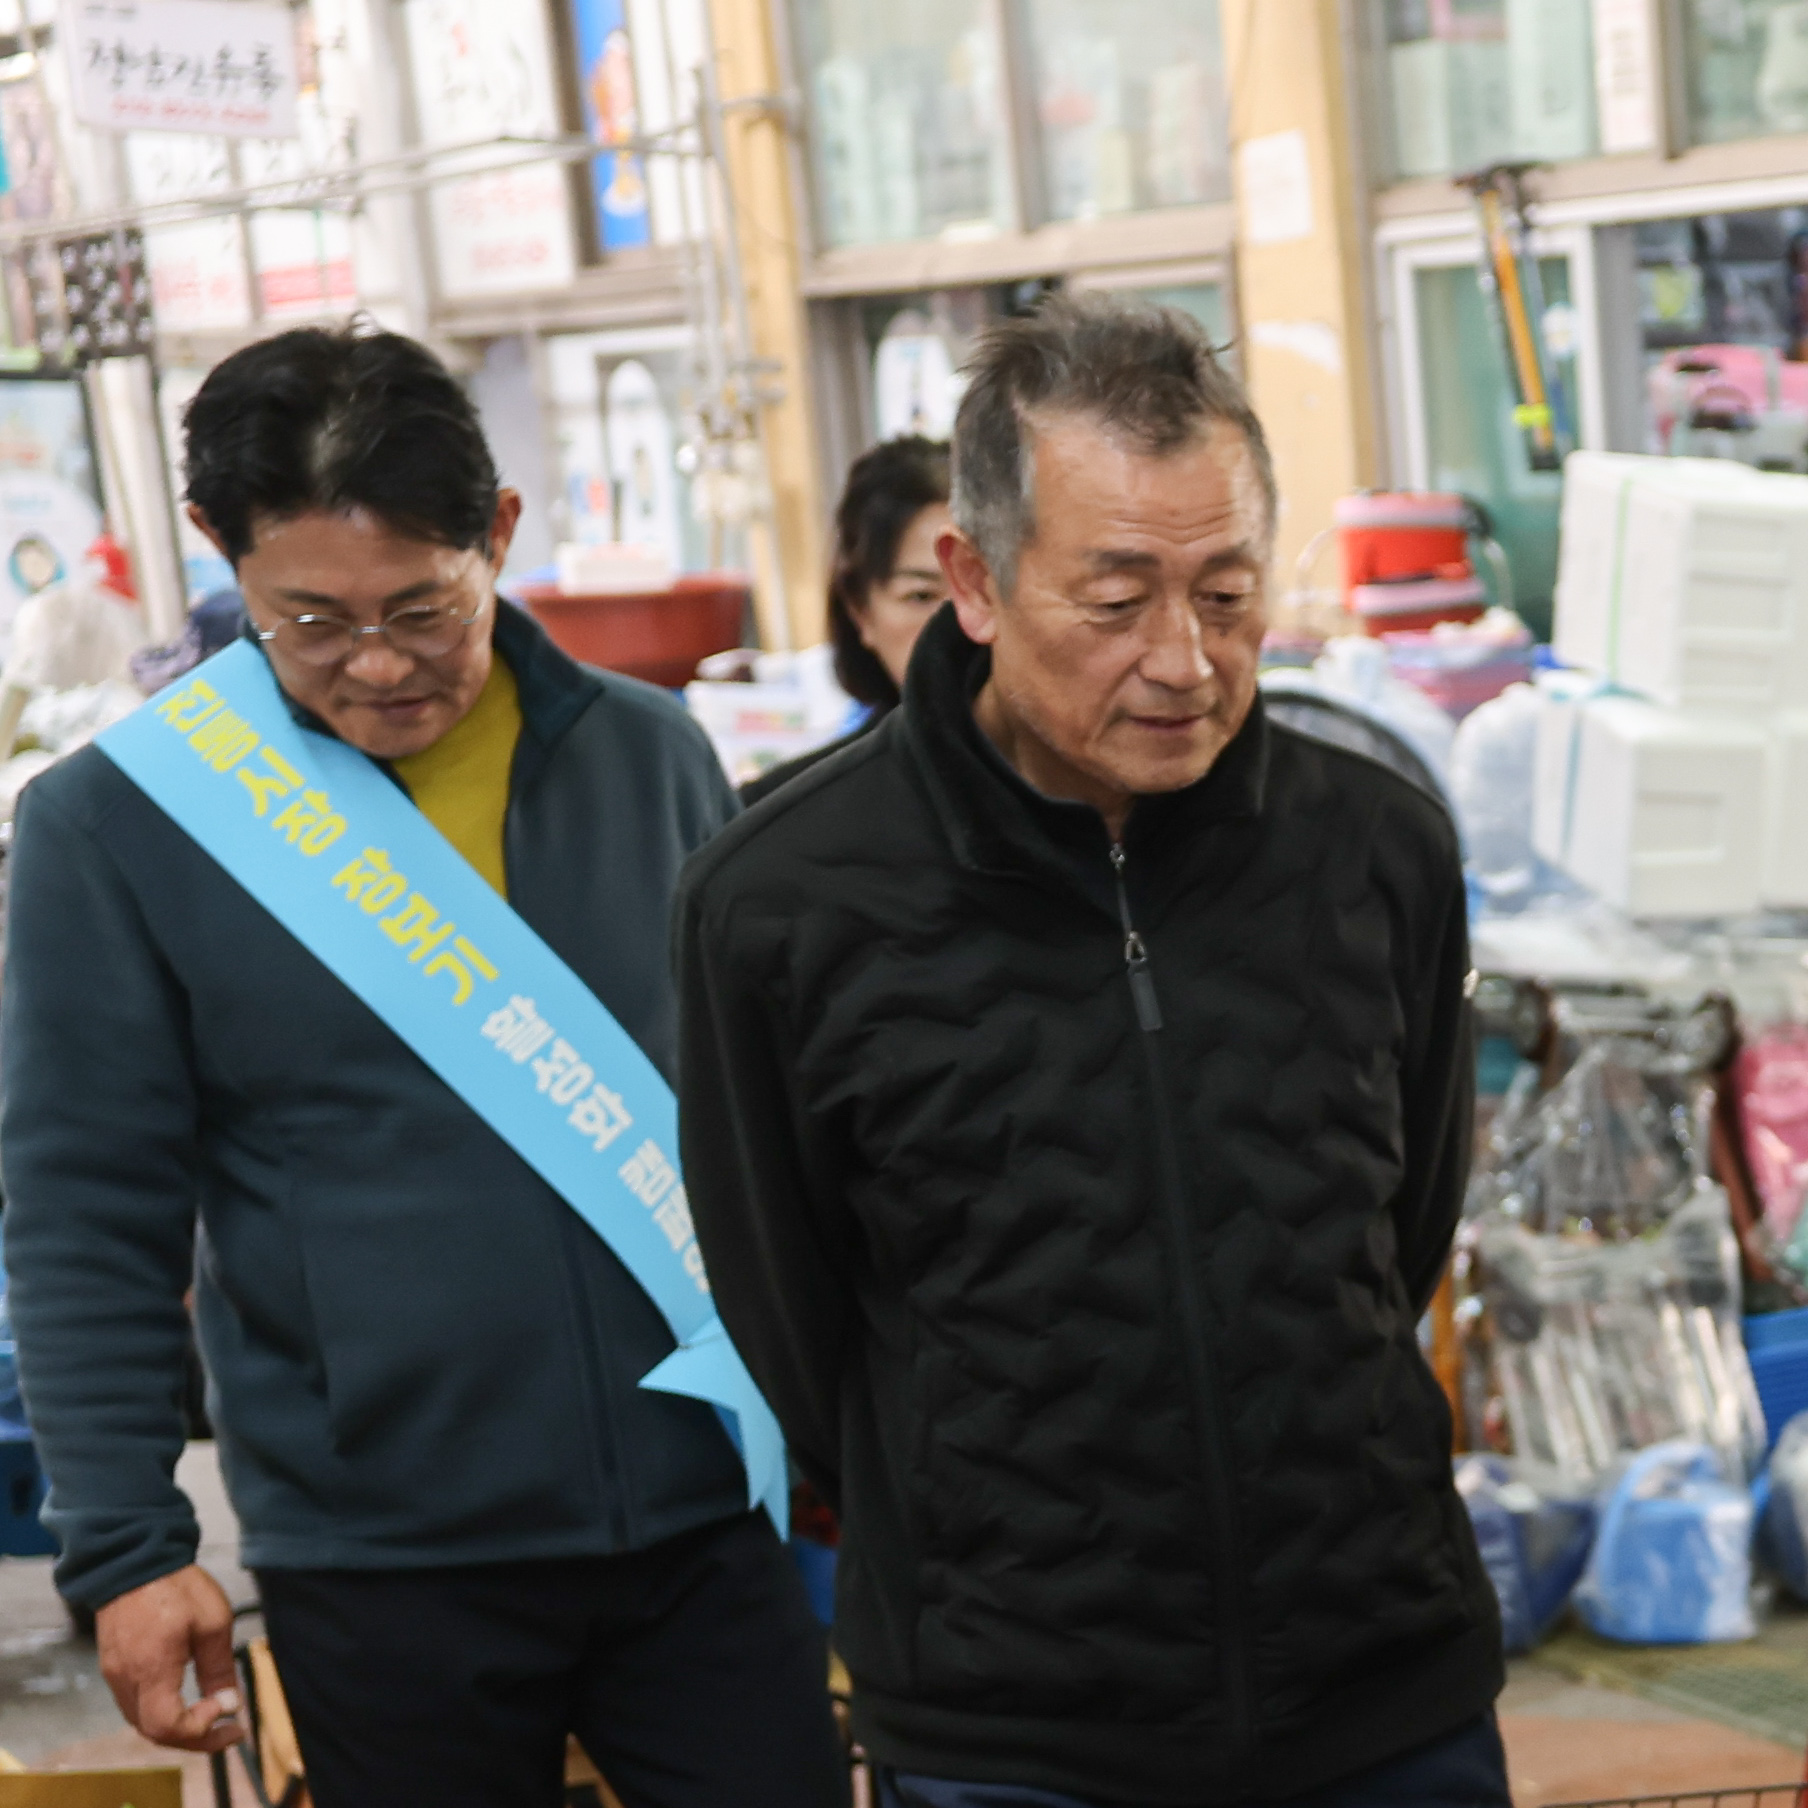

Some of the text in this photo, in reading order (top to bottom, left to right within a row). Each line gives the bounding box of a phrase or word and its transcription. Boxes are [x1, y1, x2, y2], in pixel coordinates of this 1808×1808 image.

[156, 680, 348, 856] 전통시장
[332, 845, 498, 1005] 장보기
[480, 994, 635, 1152] 활성화
